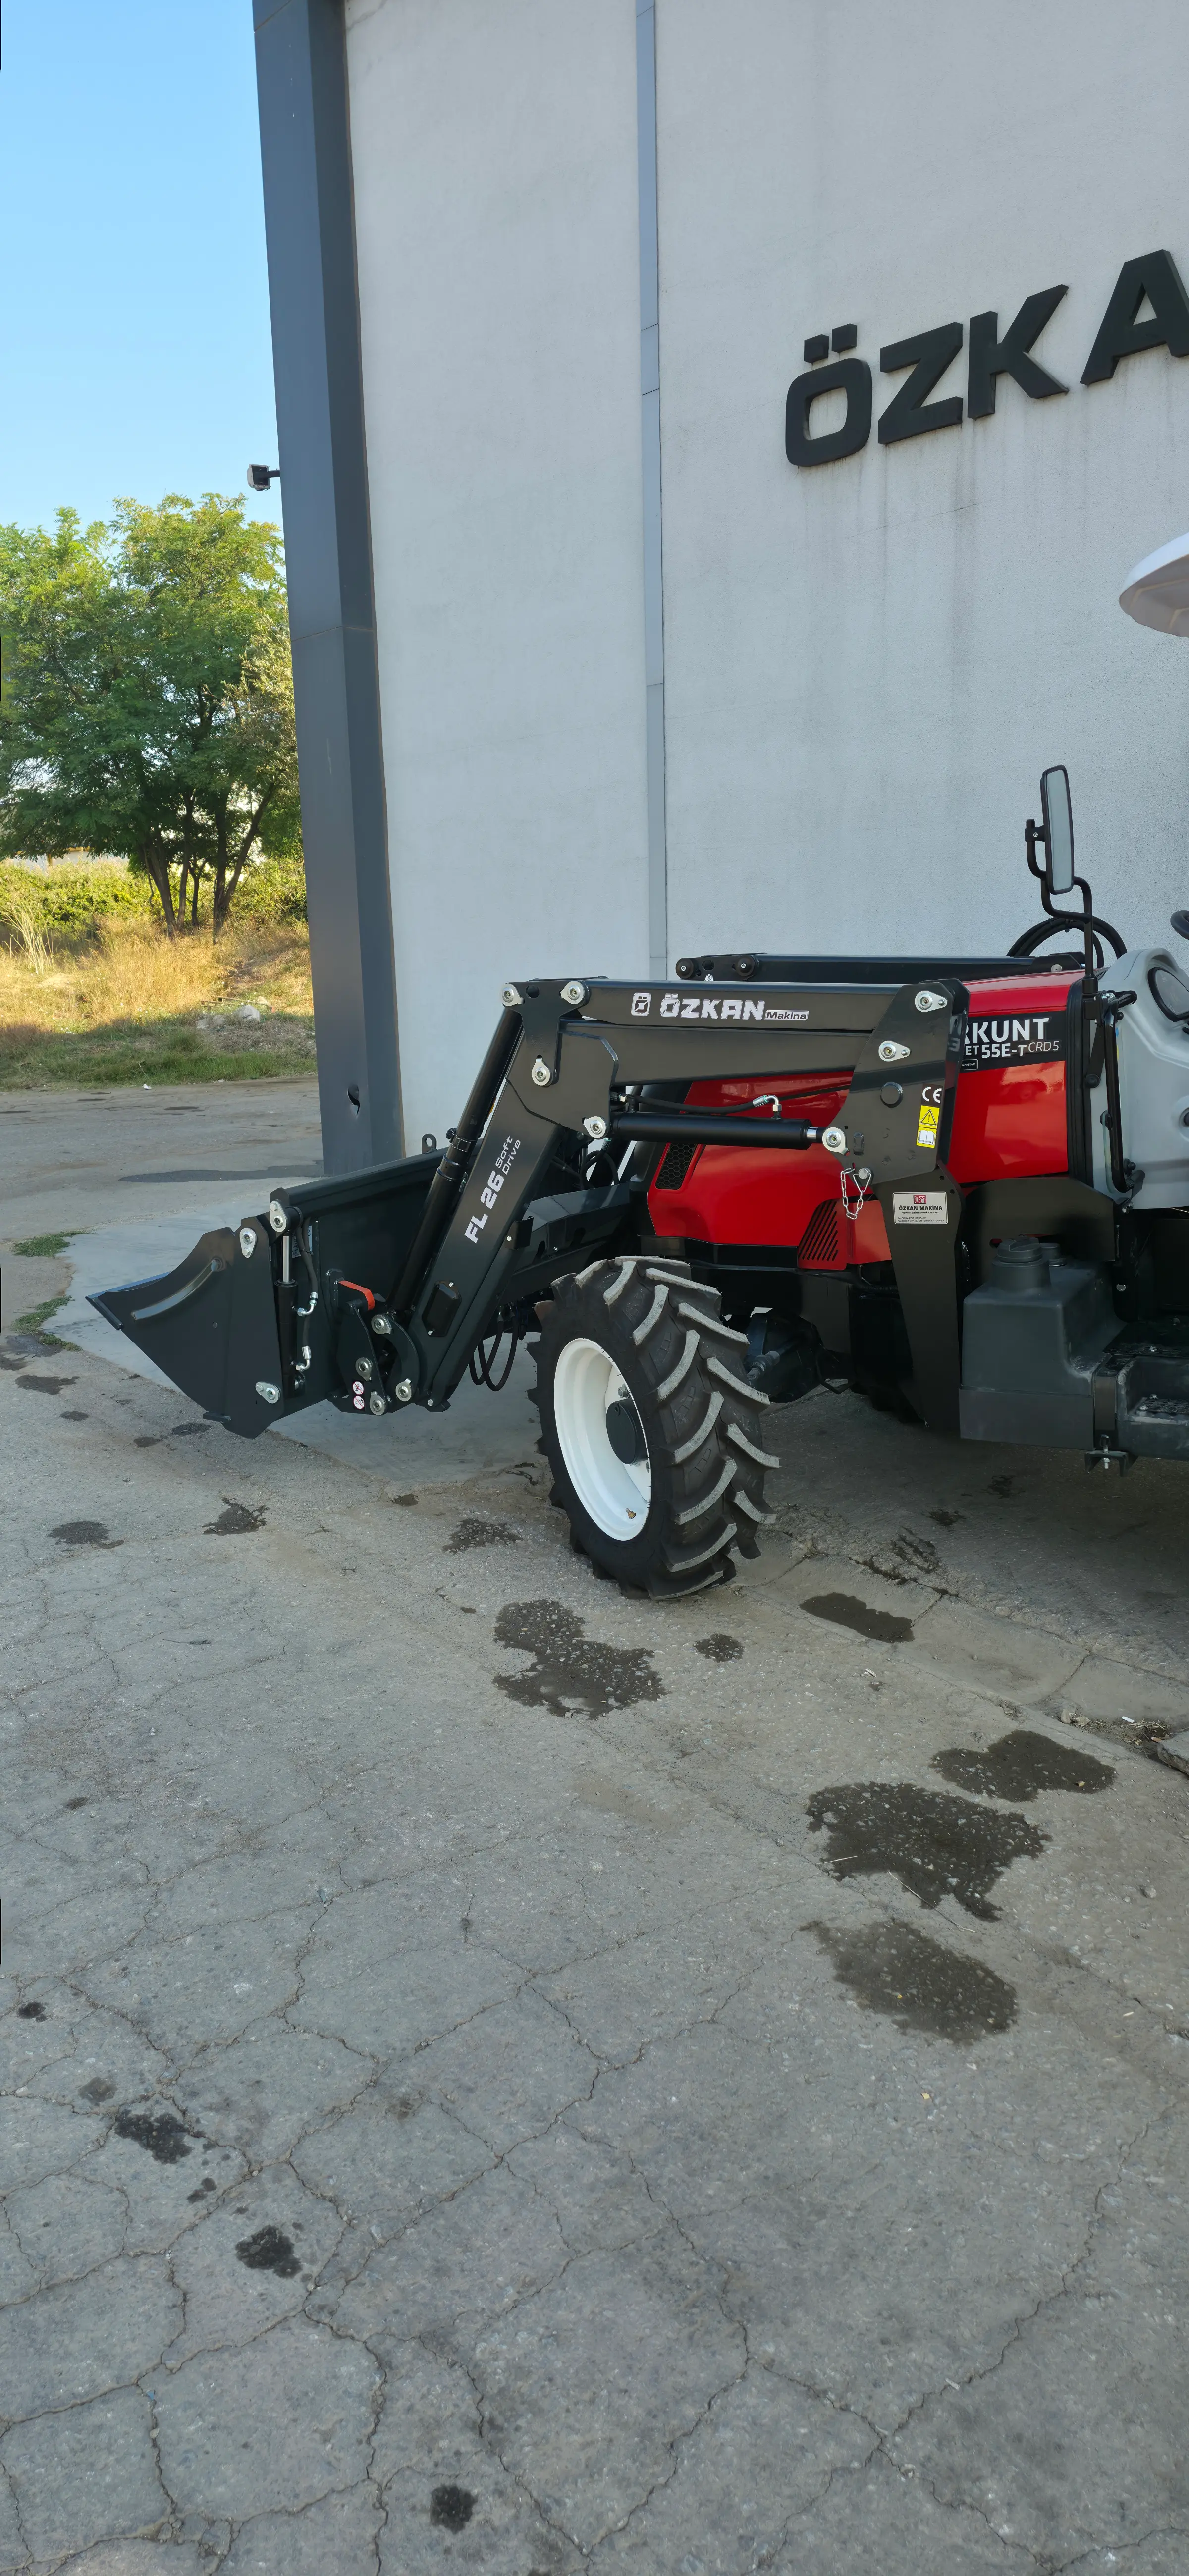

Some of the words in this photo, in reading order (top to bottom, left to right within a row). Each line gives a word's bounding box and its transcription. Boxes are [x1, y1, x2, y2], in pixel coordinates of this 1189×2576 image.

[785, 249, 1189, 467] ÖZKA
[660, 993, 765, 1020] ÖZKAN
[766, 1011, 807, 1020] Makina
[963, 1045, 979, 1056] ET
[495, 1135, 513, 1169] Soft
[502, 1139, 521, 1175] Drive
[464, 1213, 488, 1244] FL
[480, 1170, 504, 1210] 26
